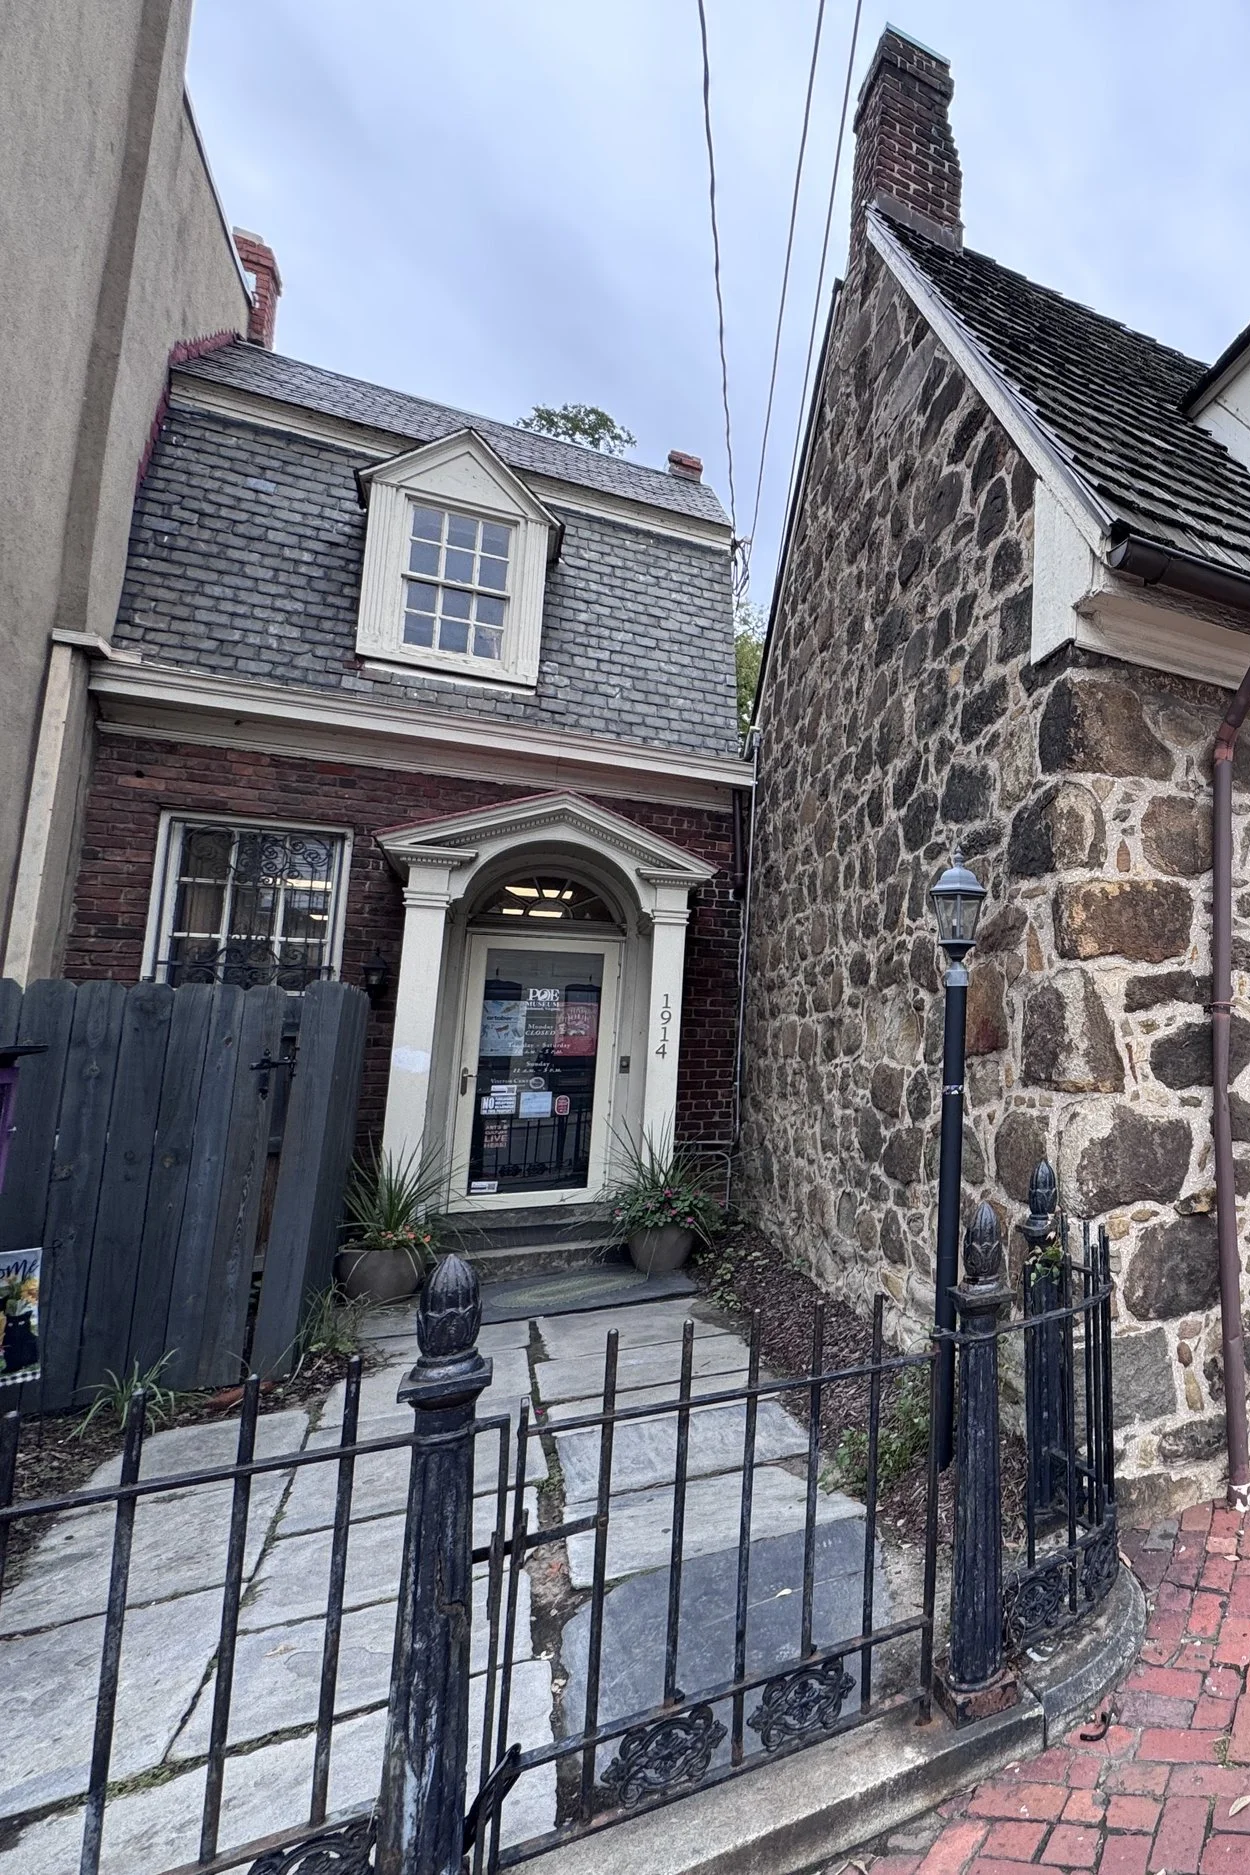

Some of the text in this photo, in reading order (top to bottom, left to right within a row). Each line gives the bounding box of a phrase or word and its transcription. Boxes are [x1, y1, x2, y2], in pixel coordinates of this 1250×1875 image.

[527, 988, 560, 1001] POE
[655, 993, 672, 1059] 1914
[482, 1097, 495, 1109] NO
